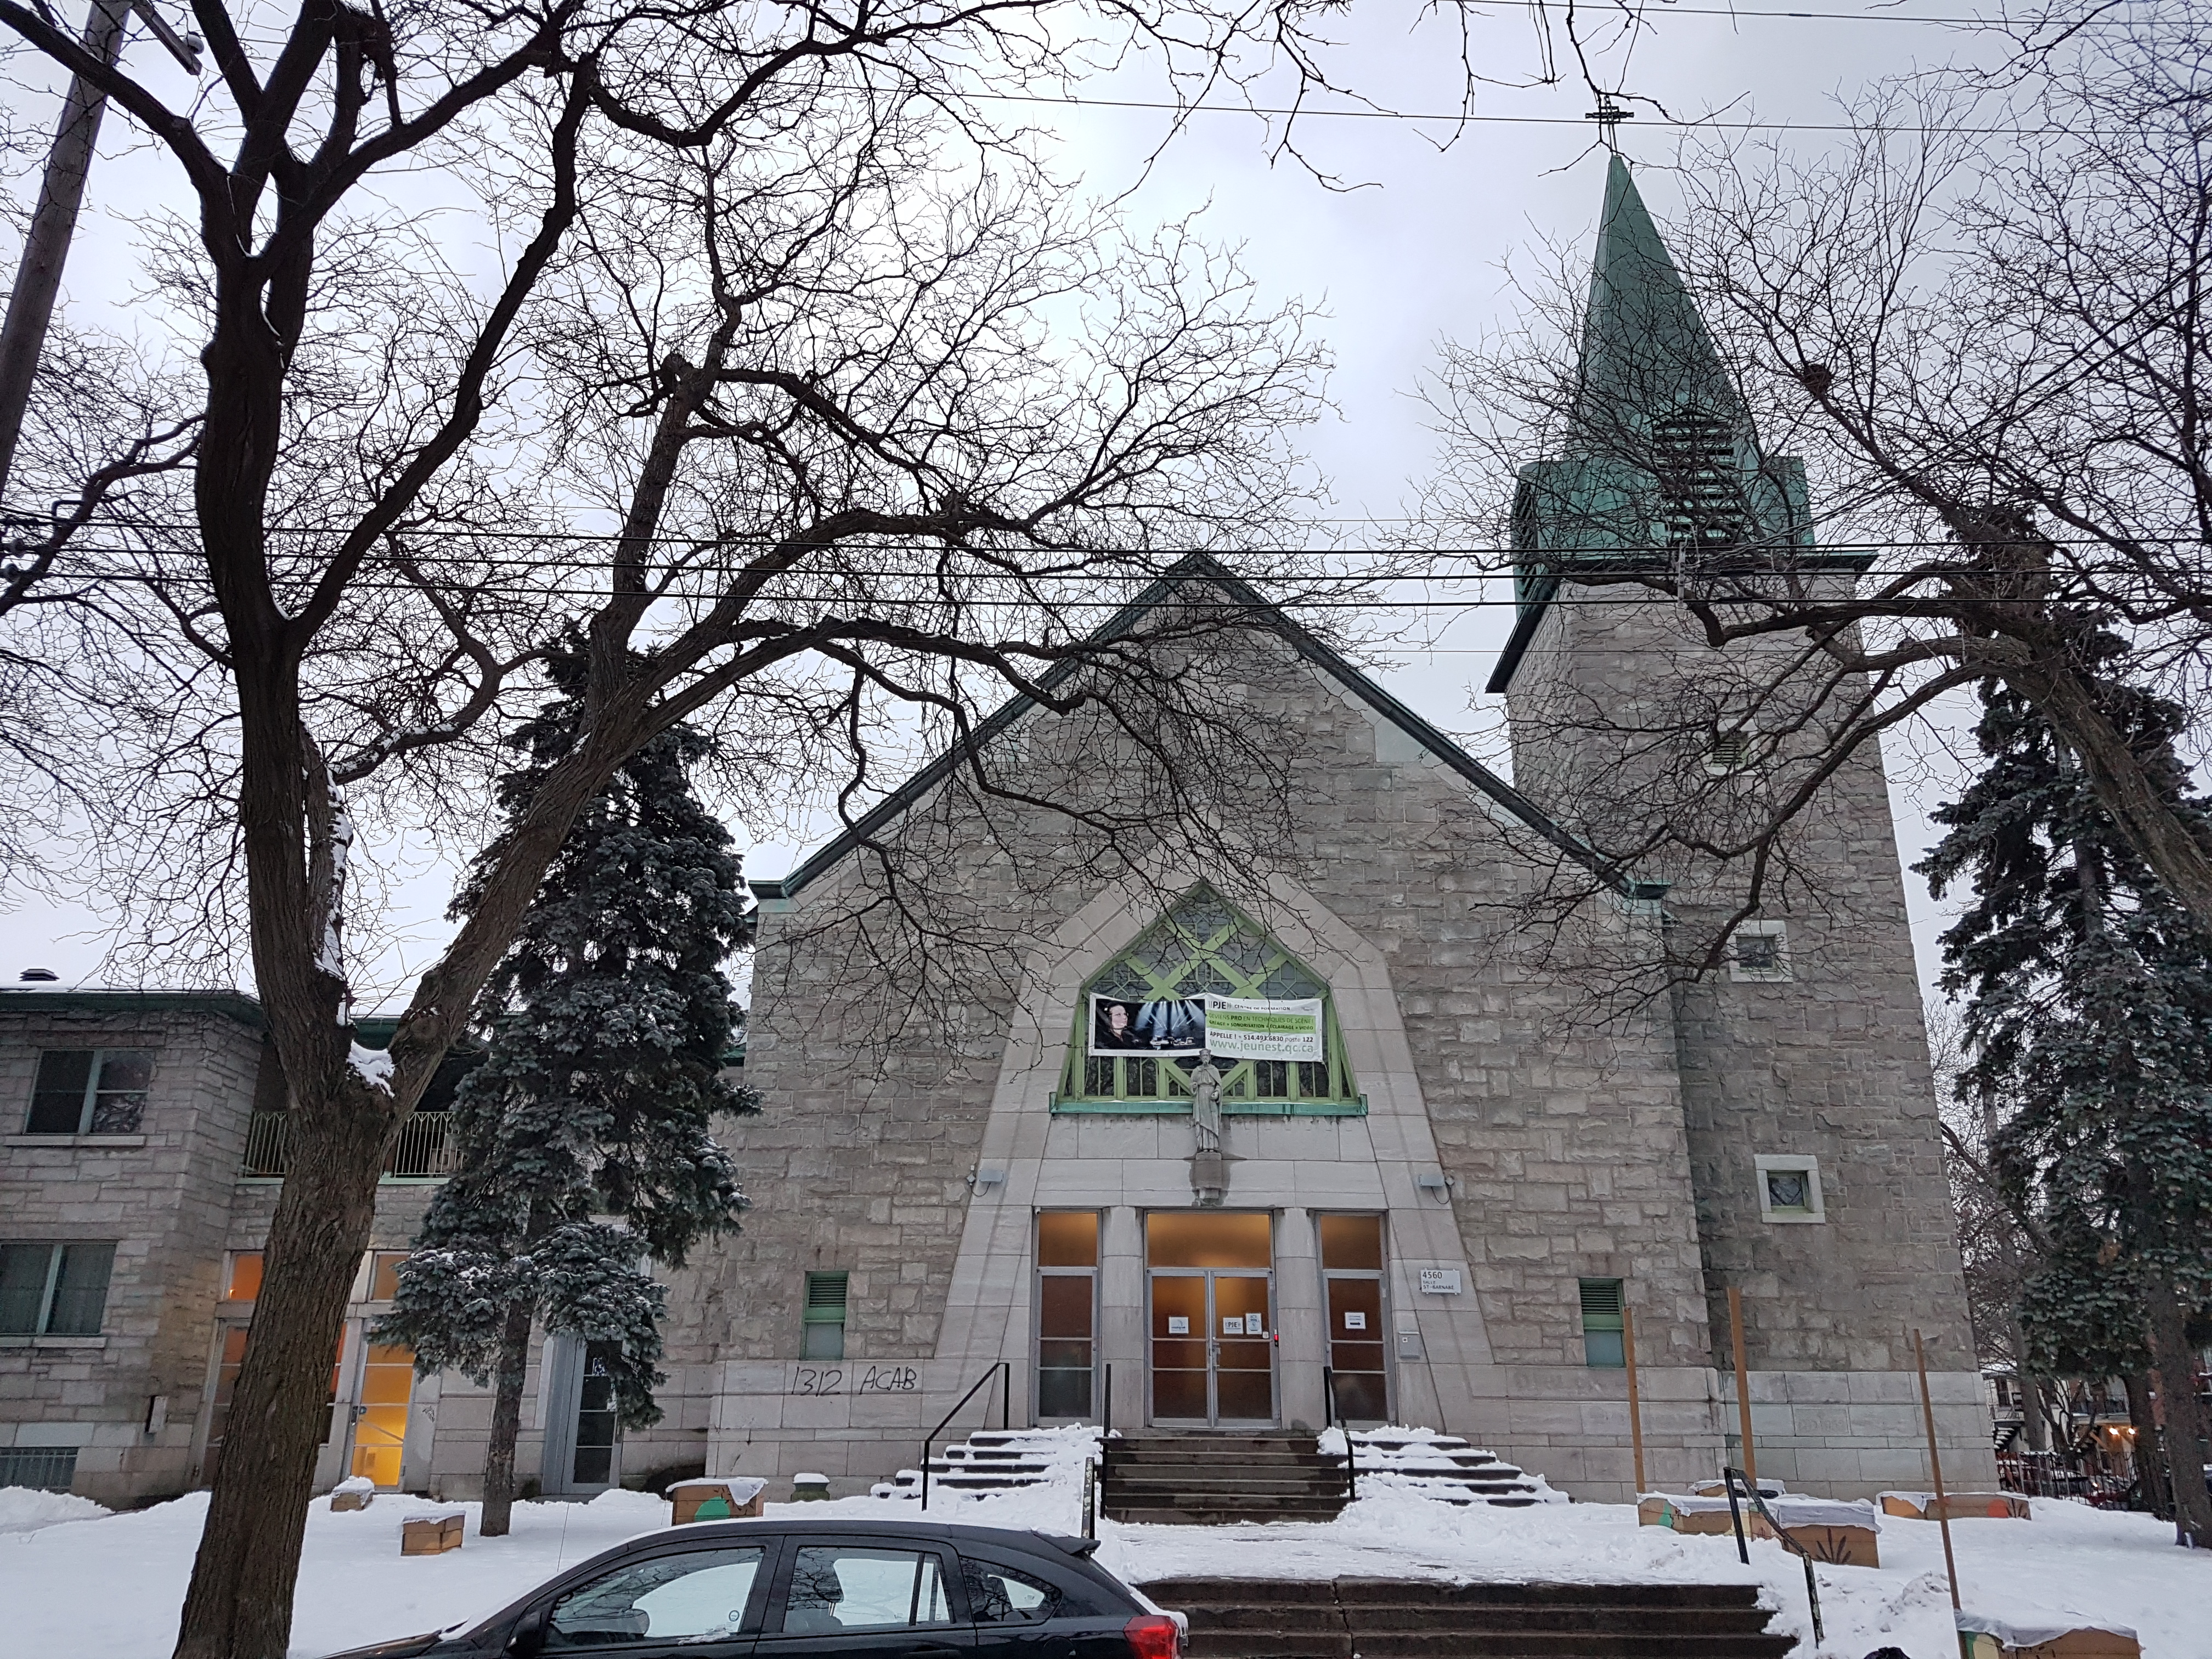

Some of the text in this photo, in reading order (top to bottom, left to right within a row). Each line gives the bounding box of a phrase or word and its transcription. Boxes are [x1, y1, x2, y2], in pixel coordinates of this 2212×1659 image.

[1210, 1039, 1313, 1054] www.jeunest.qc.ca
[791, 1365, 917, 1397] 1312 ACAB
